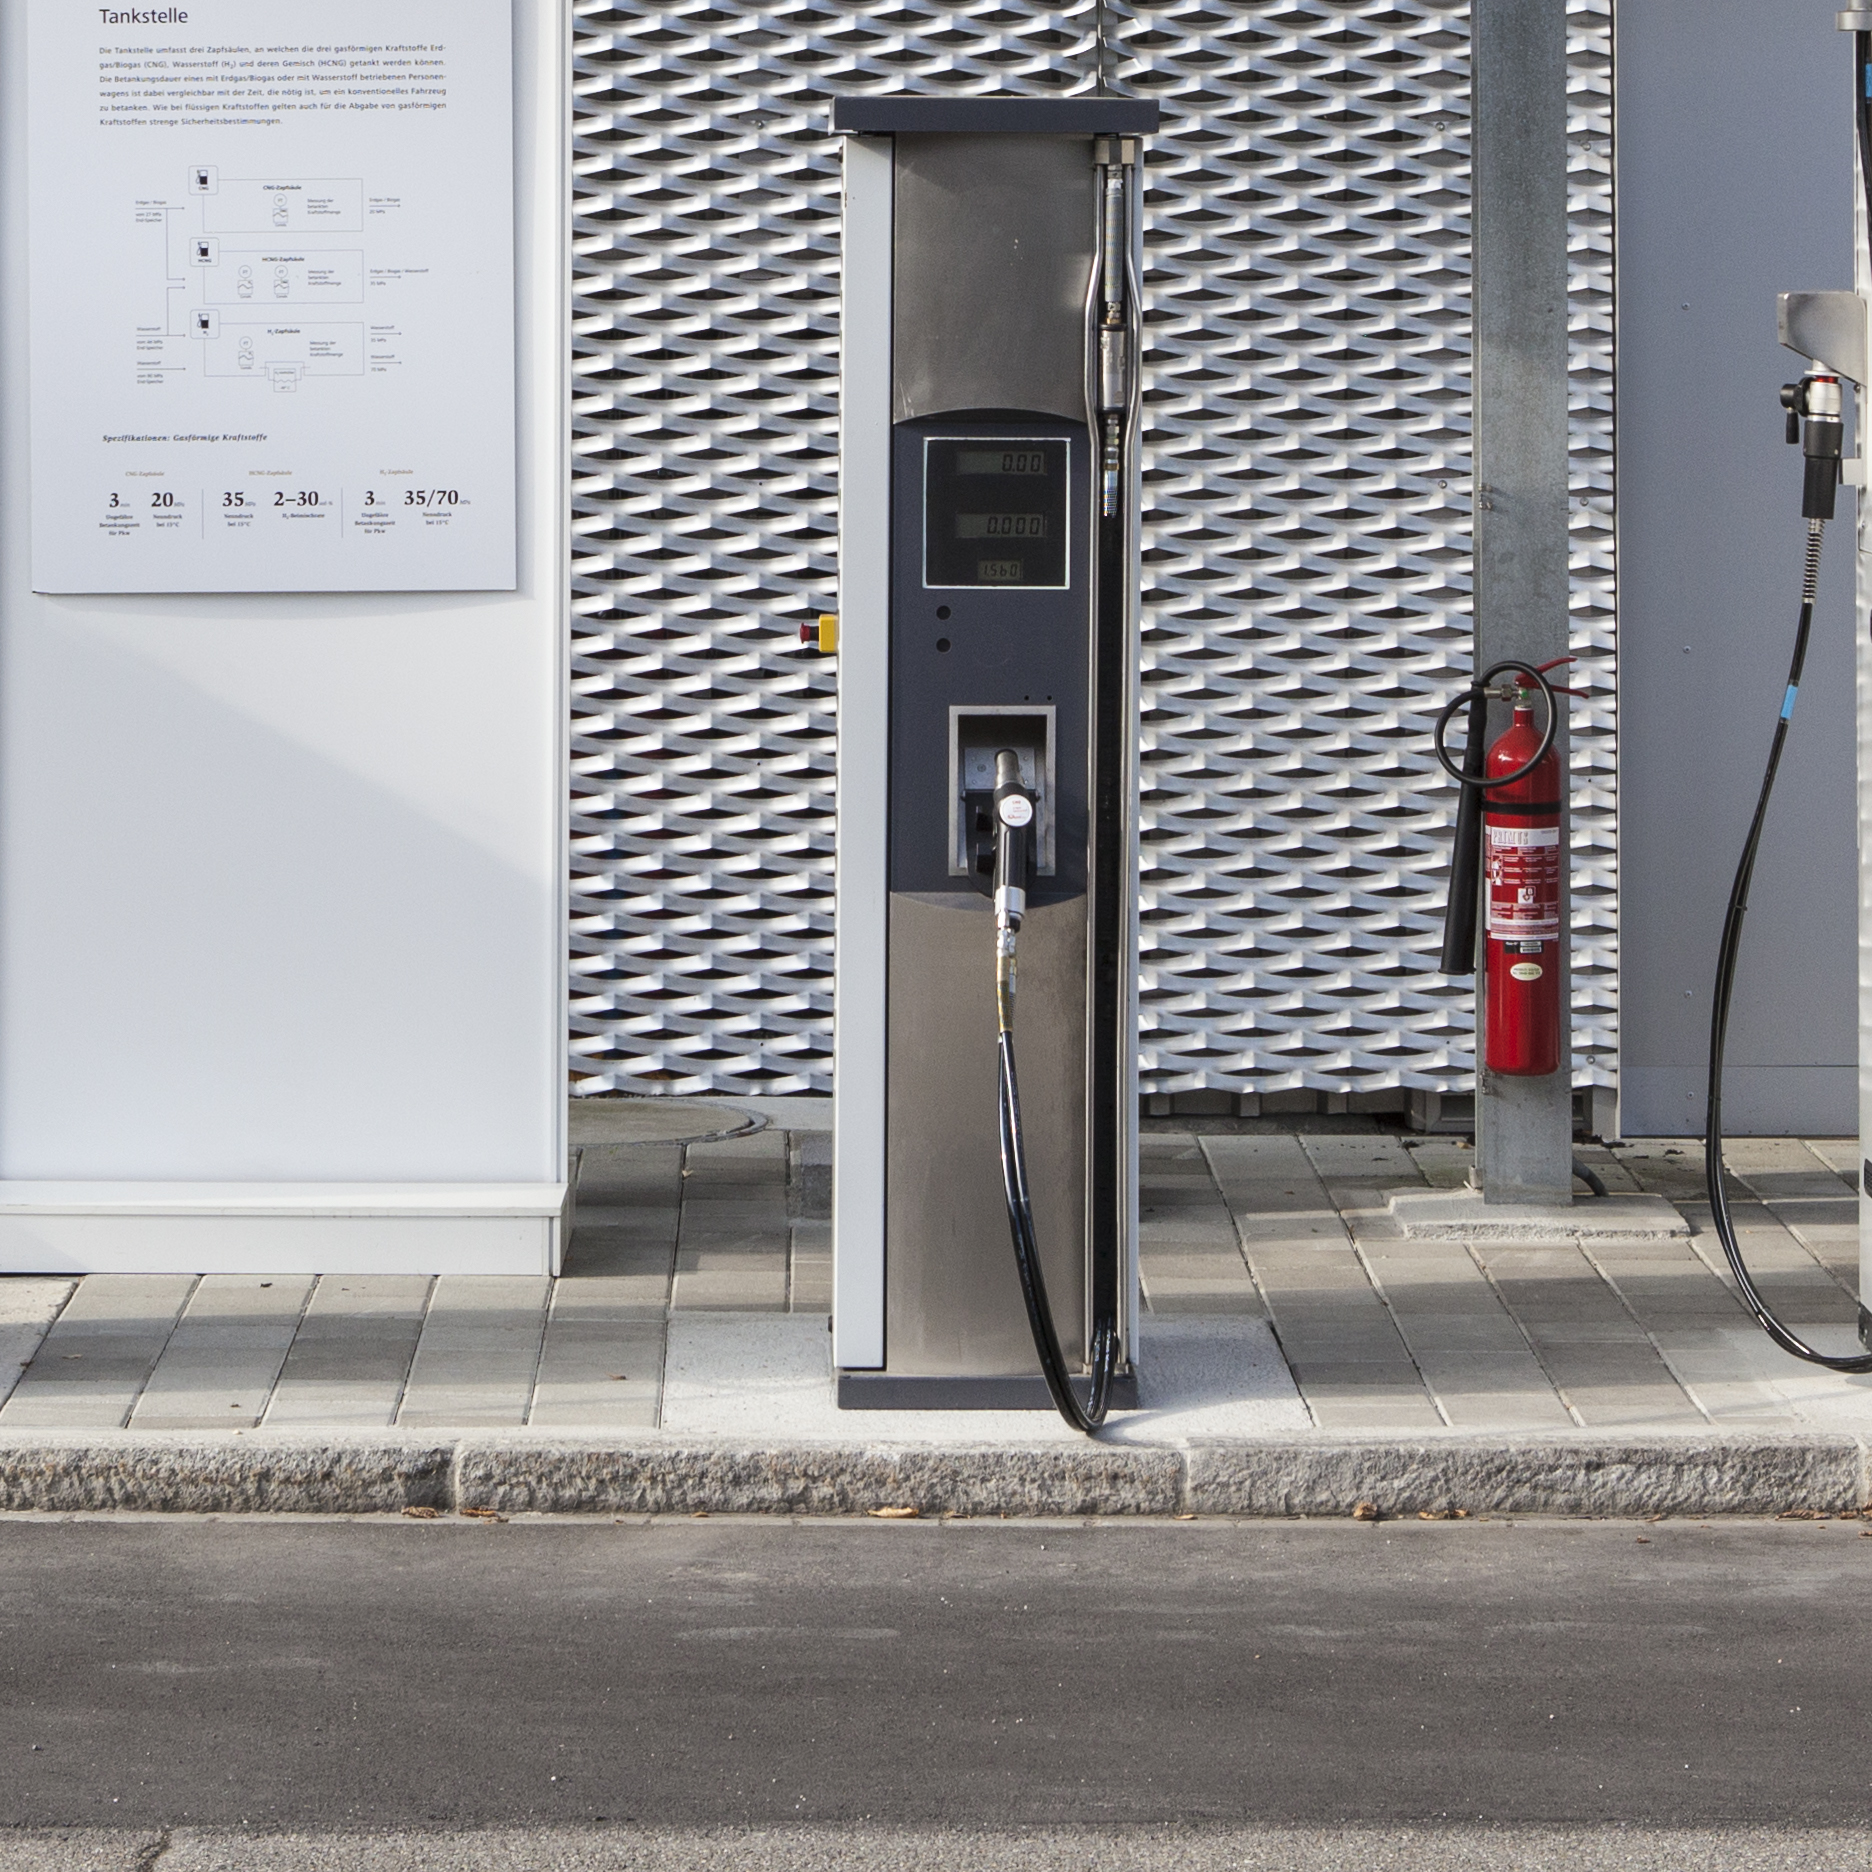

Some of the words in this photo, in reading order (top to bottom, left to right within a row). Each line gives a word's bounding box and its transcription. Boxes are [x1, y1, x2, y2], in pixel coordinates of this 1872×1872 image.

[98, 7, 188, 24] Tankstelle
[98, 46, 112, 54] Die
[114, 46, 153, 54] Tankstelle
[206, 45, 251, 54] Zapfsäulen,
[333, 44, 382, 54] gasförmigen
[98, 61, 141, 69] gas/Biogas
[256, 59, 279, 67] deren
[282, 59, 315, 67] Gemisch
[317, 59, 346, 67] (HCNG)
[349, 59, 379, 68] getankt
[414, 58, 445, 66] können.
[99, 75, 112, 83] Die
[205, 74, 218, 82] mit
[247, 88, 264, 96] Zeit,
[281, 88, 302, 97] nötig
[304, 88, 316, 96] ist,
[410, 88, 446, 96] Fahrzeug
[184, 103, 220, 112] flüssigen
[271, 102, 296, 112] gelten
[348, 102, 379, 111] Abgabe
[397, 102, 446, 110] gasförmigen
[149, 118, 179, 127] strenge
[102, 434, 170, 443] Spezifikationen:
[172, 433, 220, 442] Gasförmige
[222, 433, 267, 441] Kraftstoffe
[1002, 453, 1041, 472] 0.00
[109, 492, 120, 508] 3
[151, 492, 174, 508] 20
[222, 491, 244, 507] 35
[364, 490, 375, 506] 3
[404, 490, 459, 507] 35/70
[987, 516, 1040, 535] 0.000
